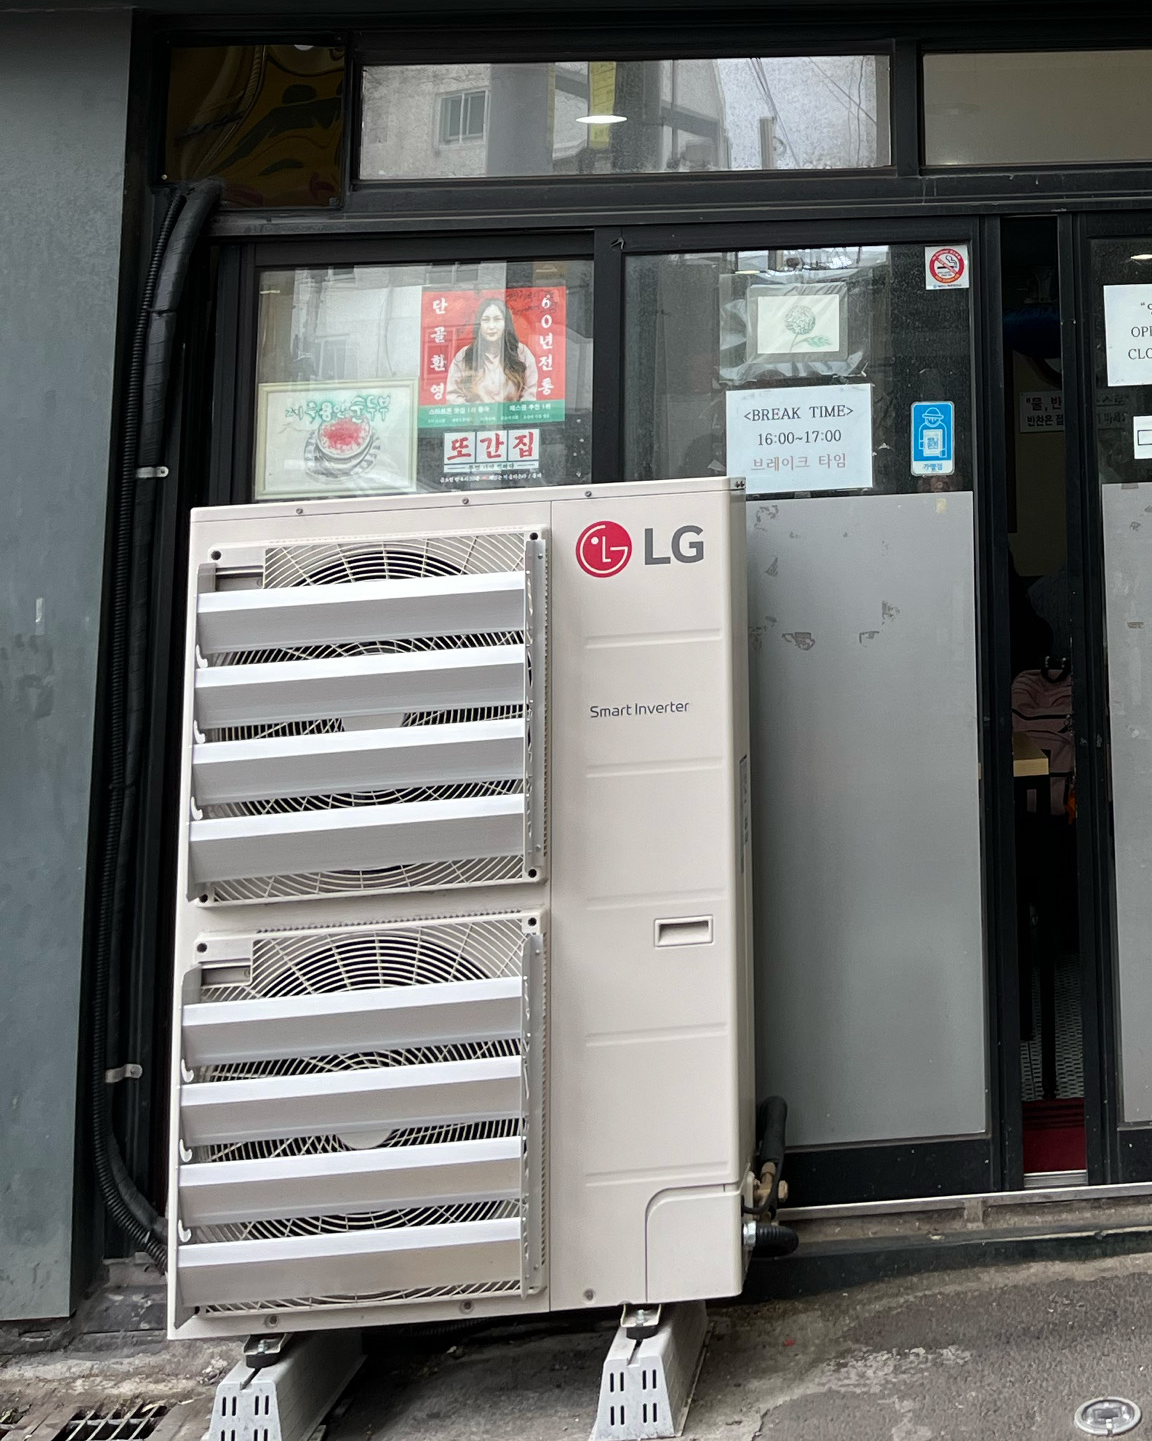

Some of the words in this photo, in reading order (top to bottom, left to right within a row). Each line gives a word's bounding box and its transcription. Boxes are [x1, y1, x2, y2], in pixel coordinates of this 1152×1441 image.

[757, 429, 842, 445] 16:00~17:00
[751, 455, 811, 472] 브레이크
[818, 453, 847, 469] 타임
[644, 524, 705, 566] LG
[590, 703, 632, 718] Smart
[634, 701, 690, 717] Inverter
